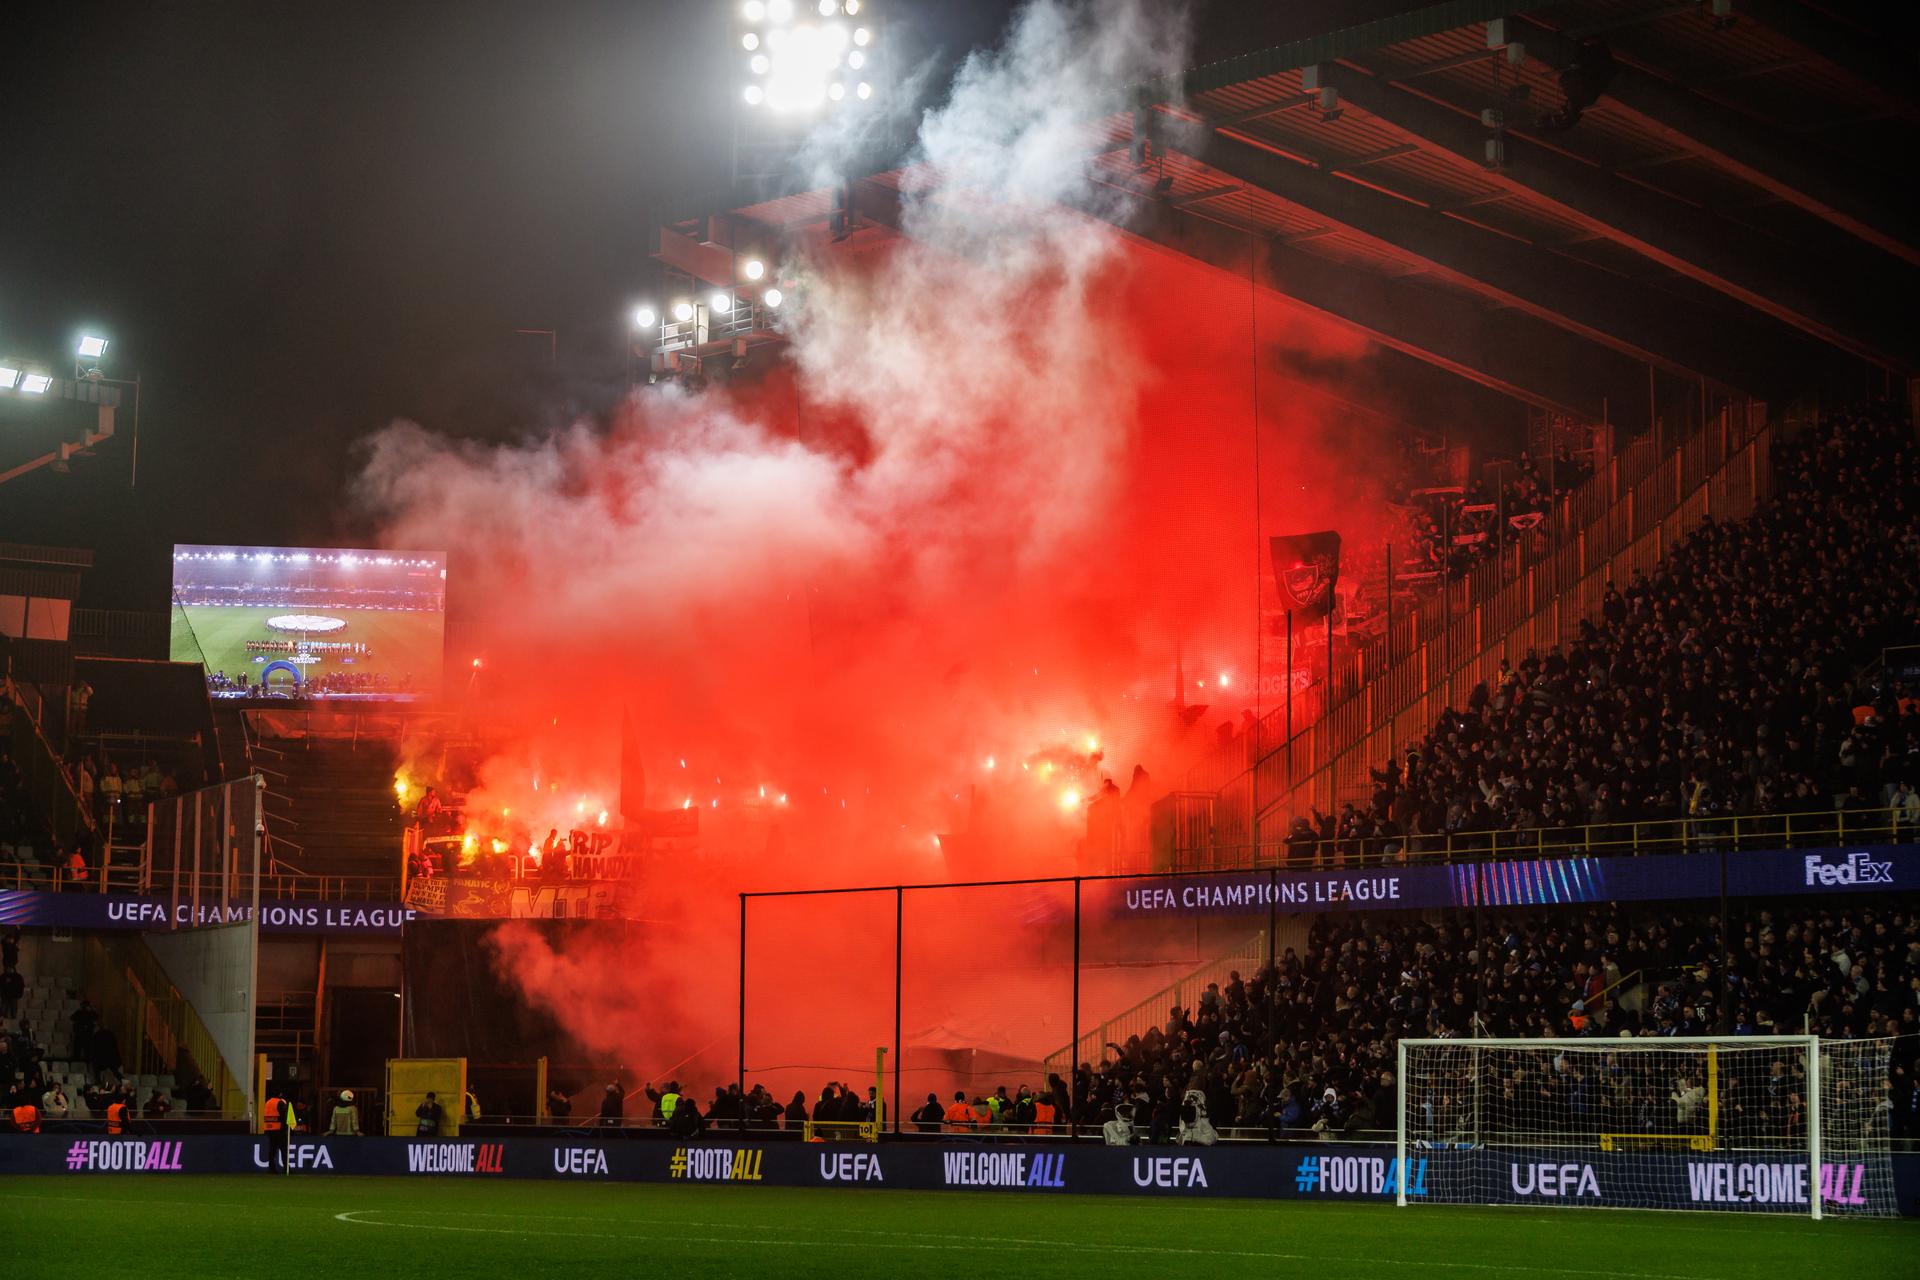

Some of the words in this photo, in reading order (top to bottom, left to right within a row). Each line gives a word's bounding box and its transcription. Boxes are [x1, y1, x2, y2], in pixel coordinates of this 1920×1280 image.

[571, 831, 613, 855] RIP
[1806, 853, 1894, 886] FedEx
[1126, 888, 1177, 910] UEFA
[1183, 882, 1308, 908] CHAMPIONS
[1315, 877, 1400, 902] LEAGUE
[107, 902, 167, 922] UEFA
[326, 908, 416, 928] LEAGUE
[66, 1141, 183, 1170] #FOOTBALL
[408, 1144, 474, 1172] WELCOME
[475, 1144, 504, 1172] ALL
[554, 1148, 609, 1174] UEFA
[670, 1148, 762, 1180] #FOOTBALL
[820, 1153, 883, 1182] UEFA
[944, 1152, 1026, 1186] WELCOME
[1027, 1153, 1065, 1187] ALL
[1133, 1157, 1208, 1187] UEFA
[1295, 1156, 1428, 1195] #FOOTBALL
[1511, 1163, 1600, 1196] UEFA
[1688, 1162, 1808, 1203] WELCOME
[1820, 1164, 1866, 1204] ALL
